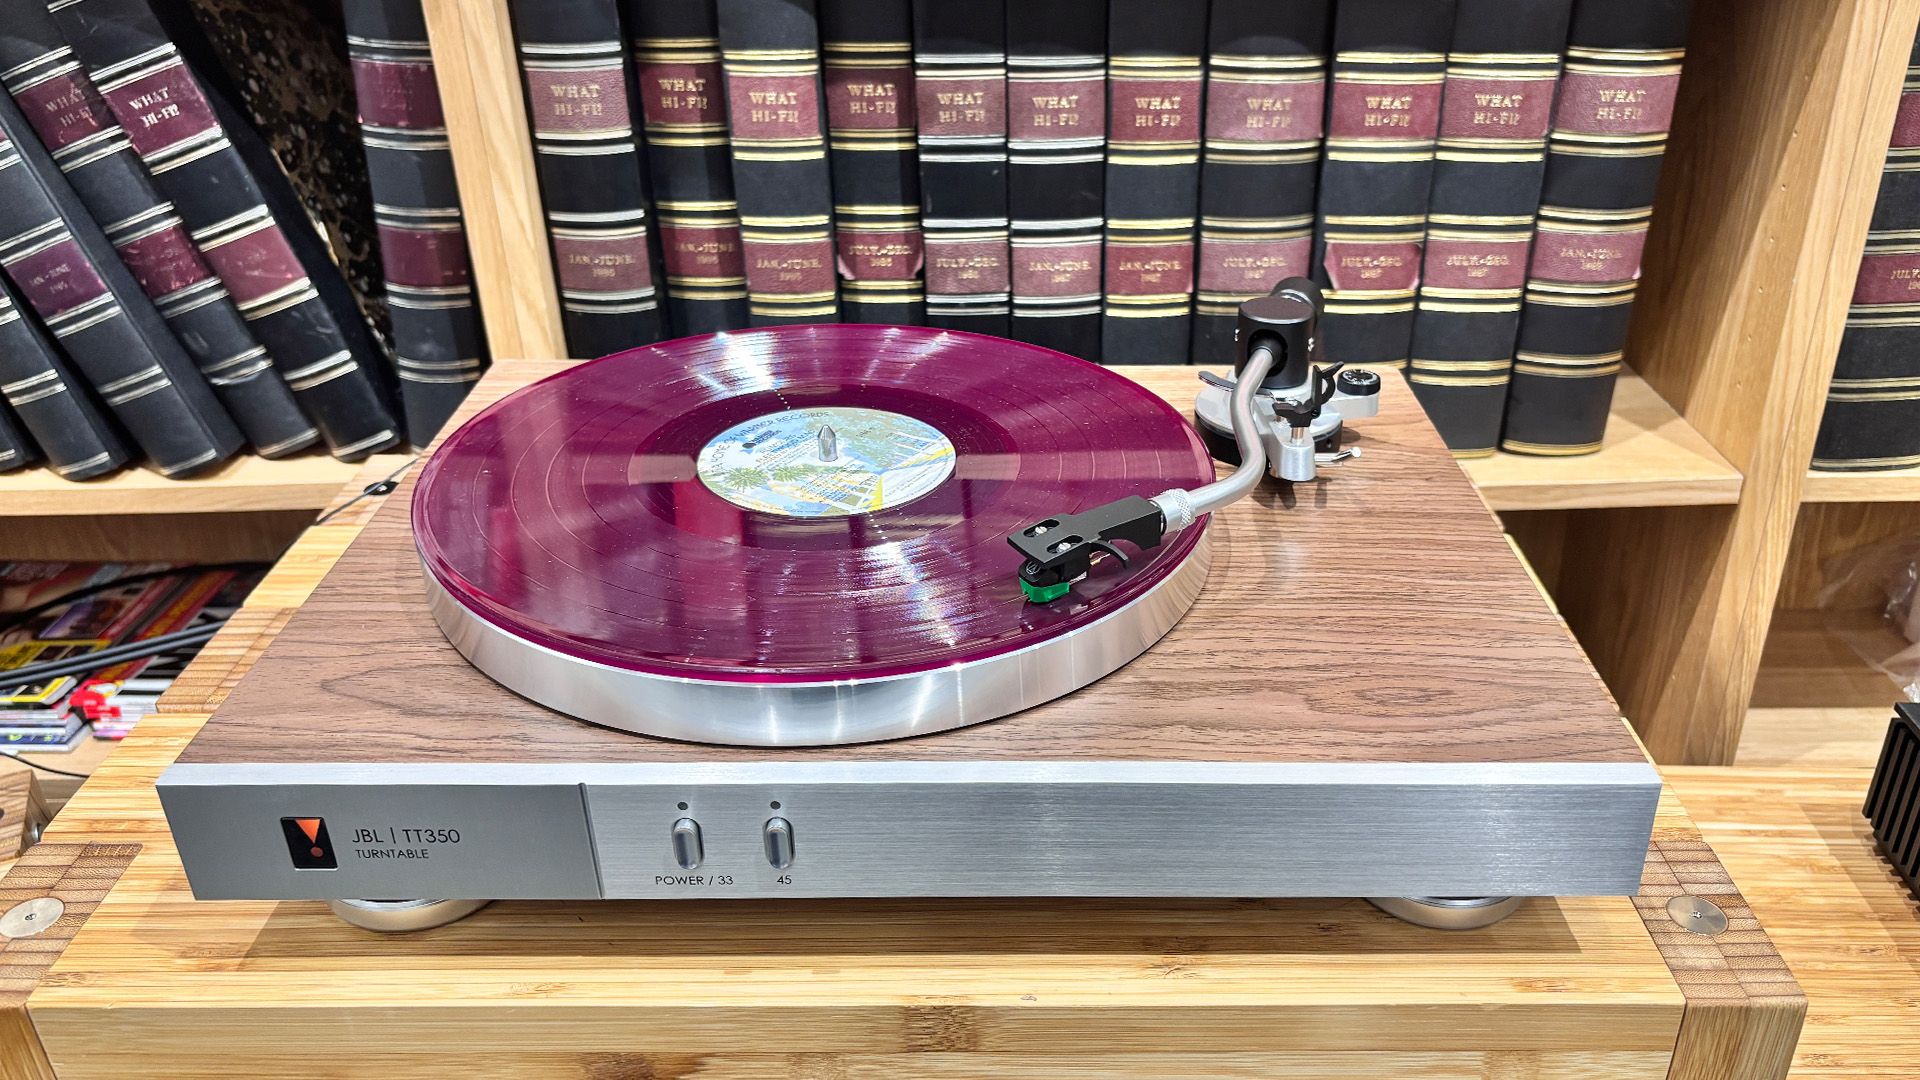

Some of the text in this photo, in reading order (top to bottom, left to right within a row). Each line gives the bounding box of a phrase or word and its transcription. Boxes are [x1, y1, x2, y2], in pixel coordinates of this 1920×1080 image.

[551, 85, 601, 98] WHAT
[659, 78, 706, 92] WHAT
[847, 84, 895, 97] WHAT
[44, 91, 86, 114] WHAT
[128, 86, 169, 111] WHAT
[749, 92, 797, 105] WHAT
[937, 92, 984, 105] WHAT
[1032, 95, 1079, 109] WHAT
[1135, 96, 1181, 110] WHAT
[1365, 96, 1413, 110] WHAT
[1475, 94, 1523, 108] WHAT
[1600, 89, 1647, 103] WHAT
[1247, 97, 1292, 111] WHAT
[352, 828, 384, 844] JBL
[402, 828, 461, 844] TT350
[355, 848, 429, 859] TURNTABLE
[655, 875, 704, 886] POWER
[718, 875, 734, 885] 33
[776, 875, 792, 885] 45
